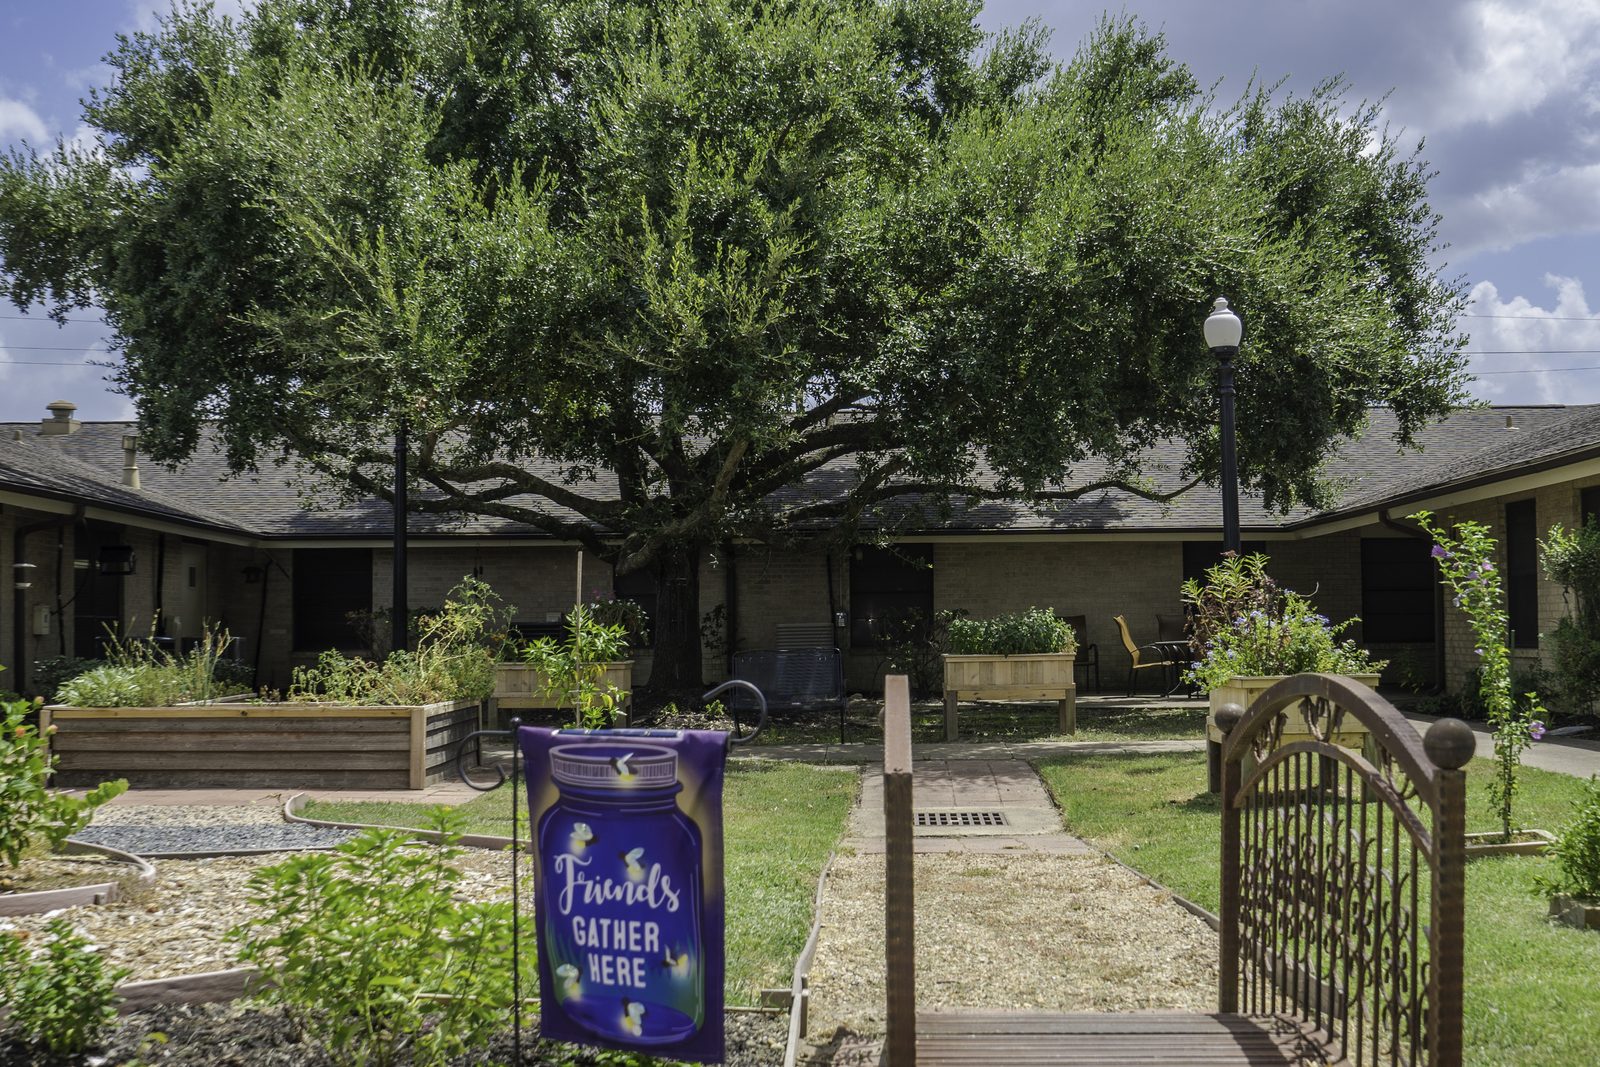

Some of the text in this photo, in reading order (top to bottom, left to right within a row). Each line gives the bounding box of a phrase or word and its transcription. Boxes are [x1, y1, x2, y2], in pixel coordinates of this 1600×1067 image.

[553, 853, 681, 915] Friends
[572, 916, 660, 952] GATHER
[588, 953, 646, 988] HERE
